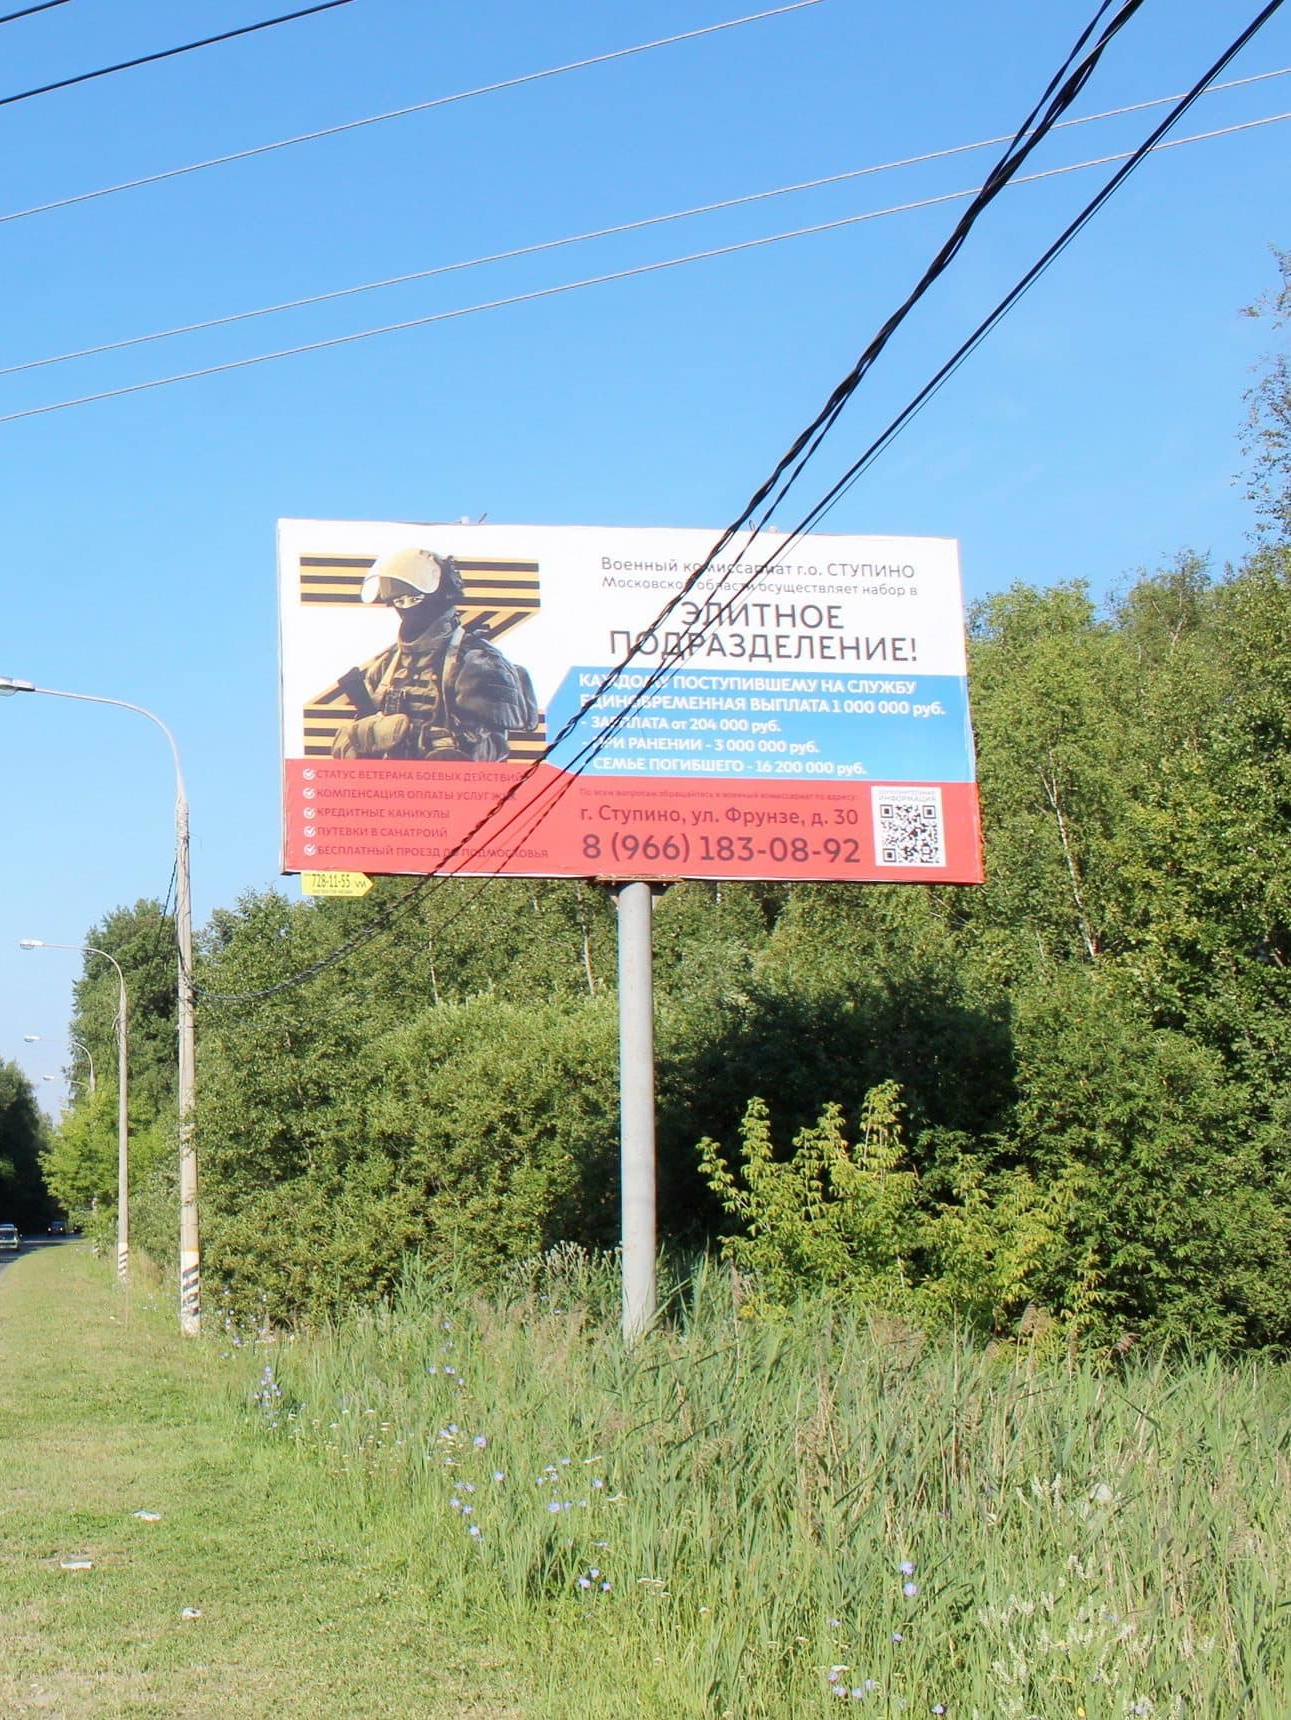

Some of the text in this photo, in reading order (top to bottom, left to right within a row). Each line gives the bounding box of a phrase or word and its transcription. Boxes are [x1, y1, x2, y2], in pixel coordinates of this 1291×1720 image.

[601, 557, 678, 572] Военный
[796, 565, 823, 576] г.о.
[827, 563, 915, 579] СТУПИНО
[602, 576, 689, 590] Московско
[758, 583, 858, 597] осуществляет
[862, 584, 906, 597] набор
[910, 587, 918, 596] в
[681, 601, 844, 629] ЭЛИТНОЕ
[610, 631, 917, 662] ПОДРАЗДЕЛЕНИЕ!
[673, 675, 818, 693] ПОСТУПИВШЕМУ
[821, 680, 845, 693] НА
[847, 680, 917, 695] СЛУЖБУ
[579, 694, 946, 718] ЕДИНОВРЕМЕННАЯ ВЫПЛАТА 1 000 000 руб.
[671, 720, 687, 730] от
[691, 718, 716, 731] 204
[719, 718, 748, 732] 000
[751, 720, 781, 734] руб.
[628, 737, 702, 751] РАНЕНИИ
[714, 739, 723, 752] 3
[726, 739, 755, 752] 000
[758, 740, 787, 753] 000
[789, 741, 819, 755] руб.
[593, 757, 647, 771] СЕМЬЕ
[649, 758, 744, 772] ПОГИБШЕГО
[756, 760, 772, 773] 16
[775, 761, 803, 774] 200
[805, 761, 834, 774] 000
[837, 762, 868, 776] руб.
[317, 770, 525, 783] СТАТУС ВЕТЕРАНА БОЕВЫХ ДЕЙСТВИЙ
[317, 788, 405, 800] КОМПЕНСАЦИЯ
[407, 790, 454, 800] ОПЛАТЫ
[457, 791, 488, 801] УСЛУГ
[317, 808, 450, 819] КРЕДИТНЫЕ КАНИКУЛЫ
[580, 805, 859, 828] г. Ступино, ул. Фрунзе, д. 30
[318, 827, 368, 836] ПУТЕВКИ
[371, 828, 378, 836] В
[318, 845, 549, 858] БЕСПЛАТНЫЙ ПРОЕЗД Д ПОДМОСКОВЬЯ
[582, 833, 861, 863] 8 (966) 183-08-92
[311, 873, 351, 888] 728-11-55
